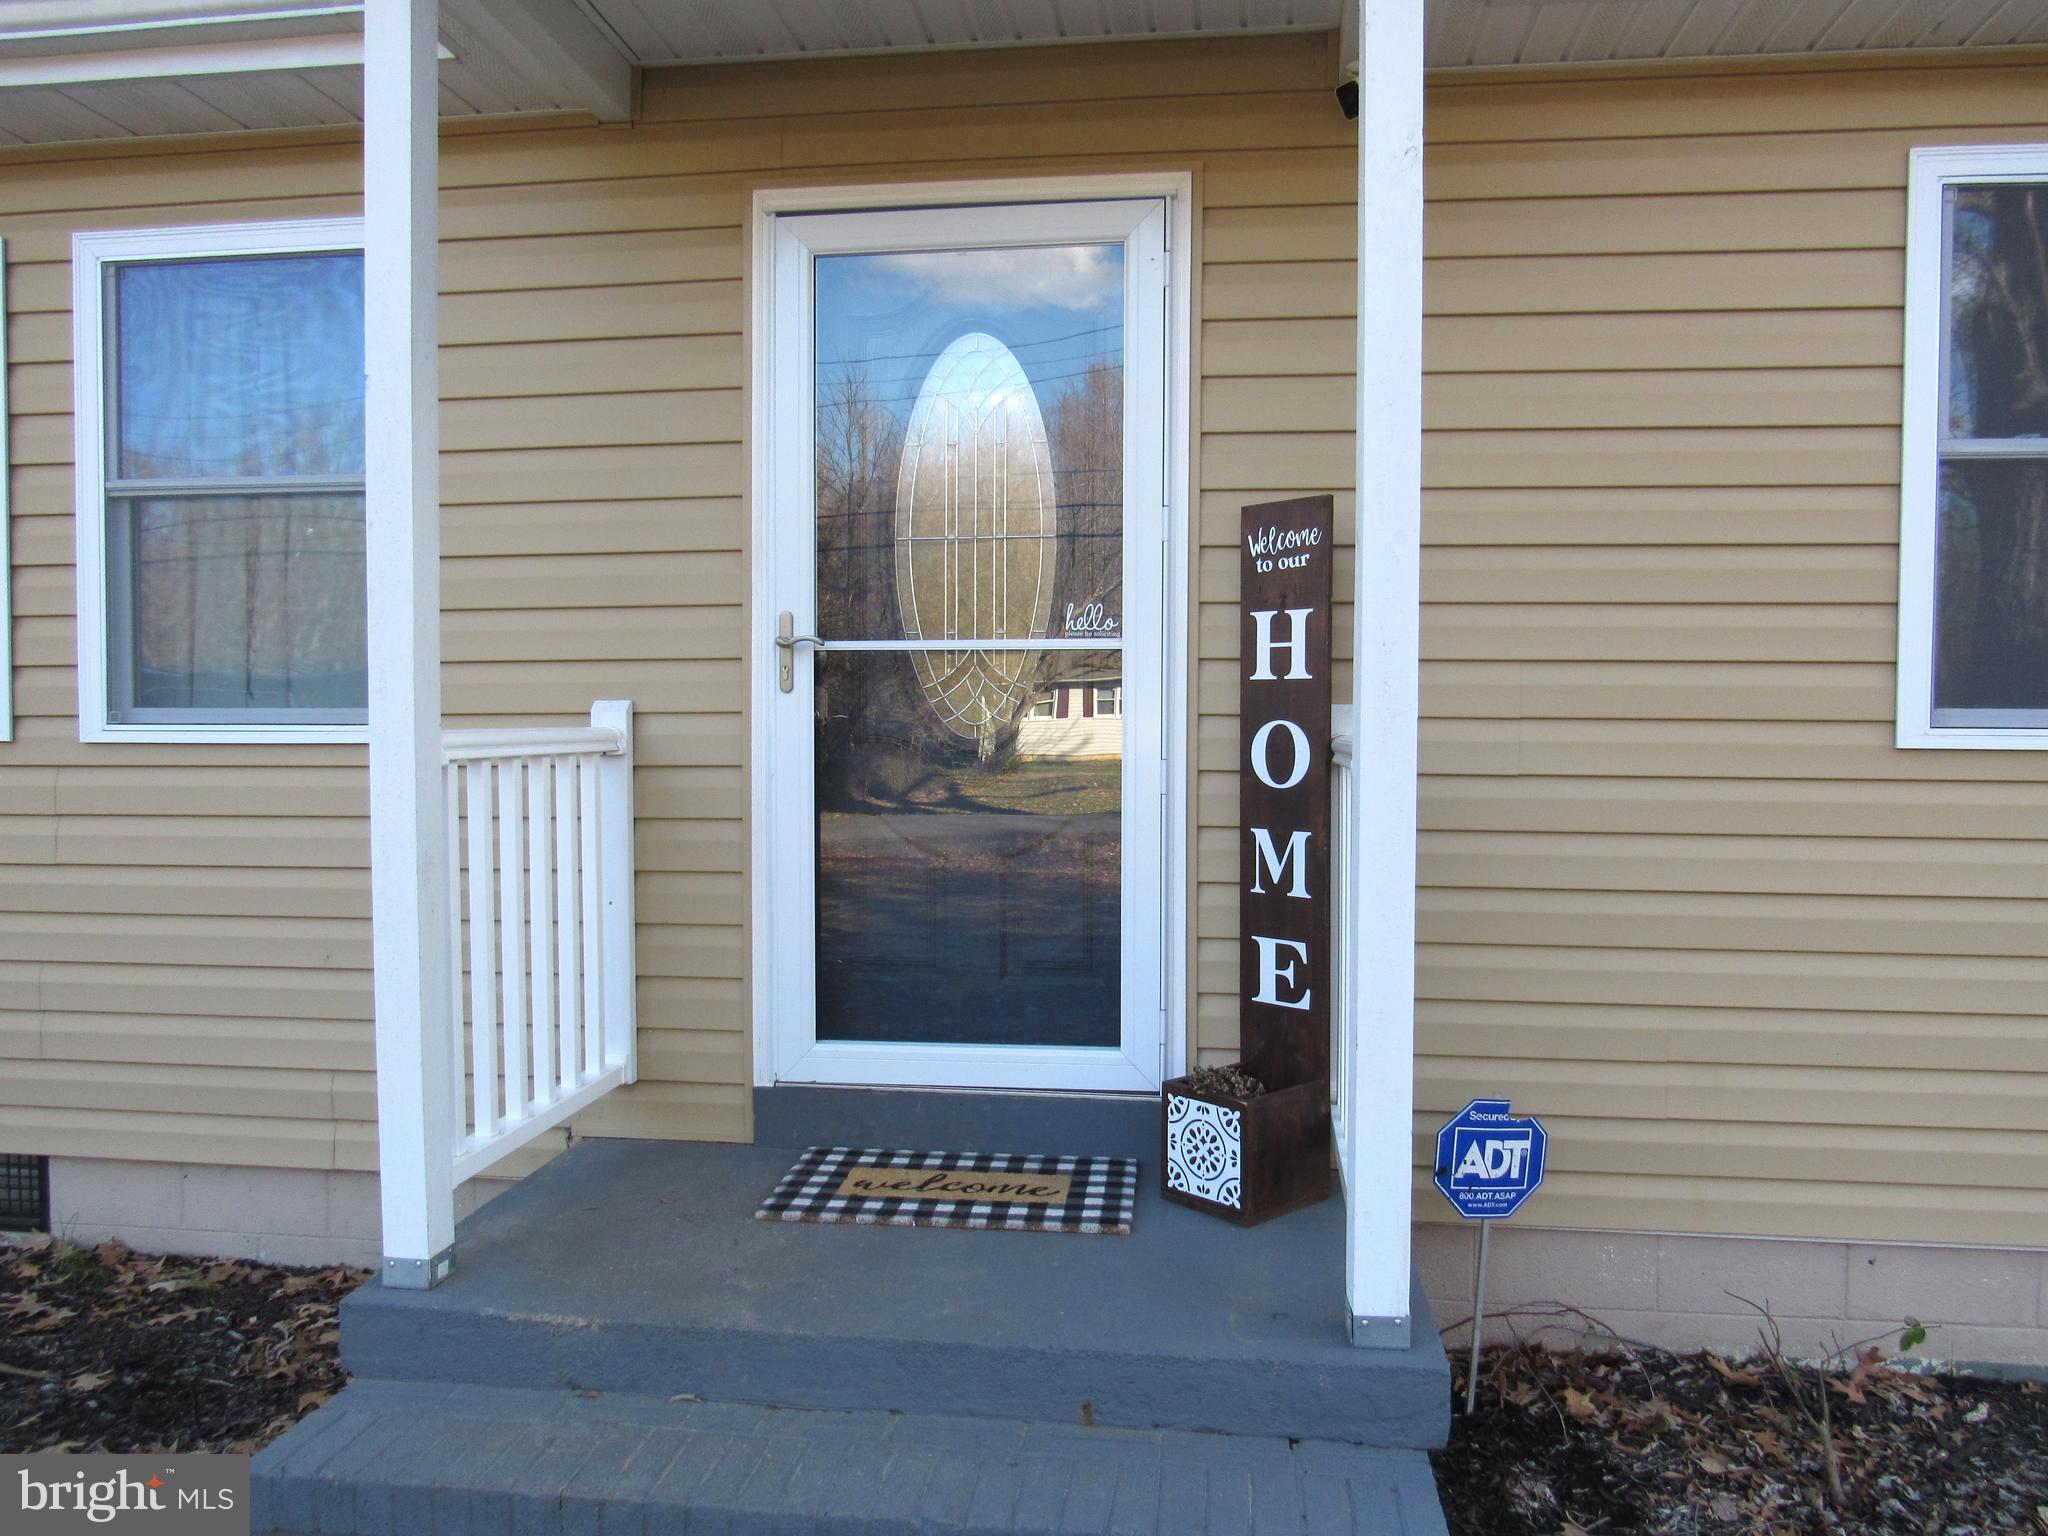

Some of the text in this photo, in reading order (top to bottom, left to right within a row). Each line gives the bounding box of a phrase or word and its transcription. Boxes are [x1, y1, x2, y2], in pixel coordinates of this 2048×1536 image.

[1248, 526, 1322, 557] Welcome
[1256, 553, 1310, 573] to our
[1065, 603, 1119, 630] hello
[1065, 630, 1083, 638] please
[1249, 608, 1313, 1011] HOME
[1454, 1139, 1531, 1179] ADT
[853, 1173, 1060, 1197] welcome
